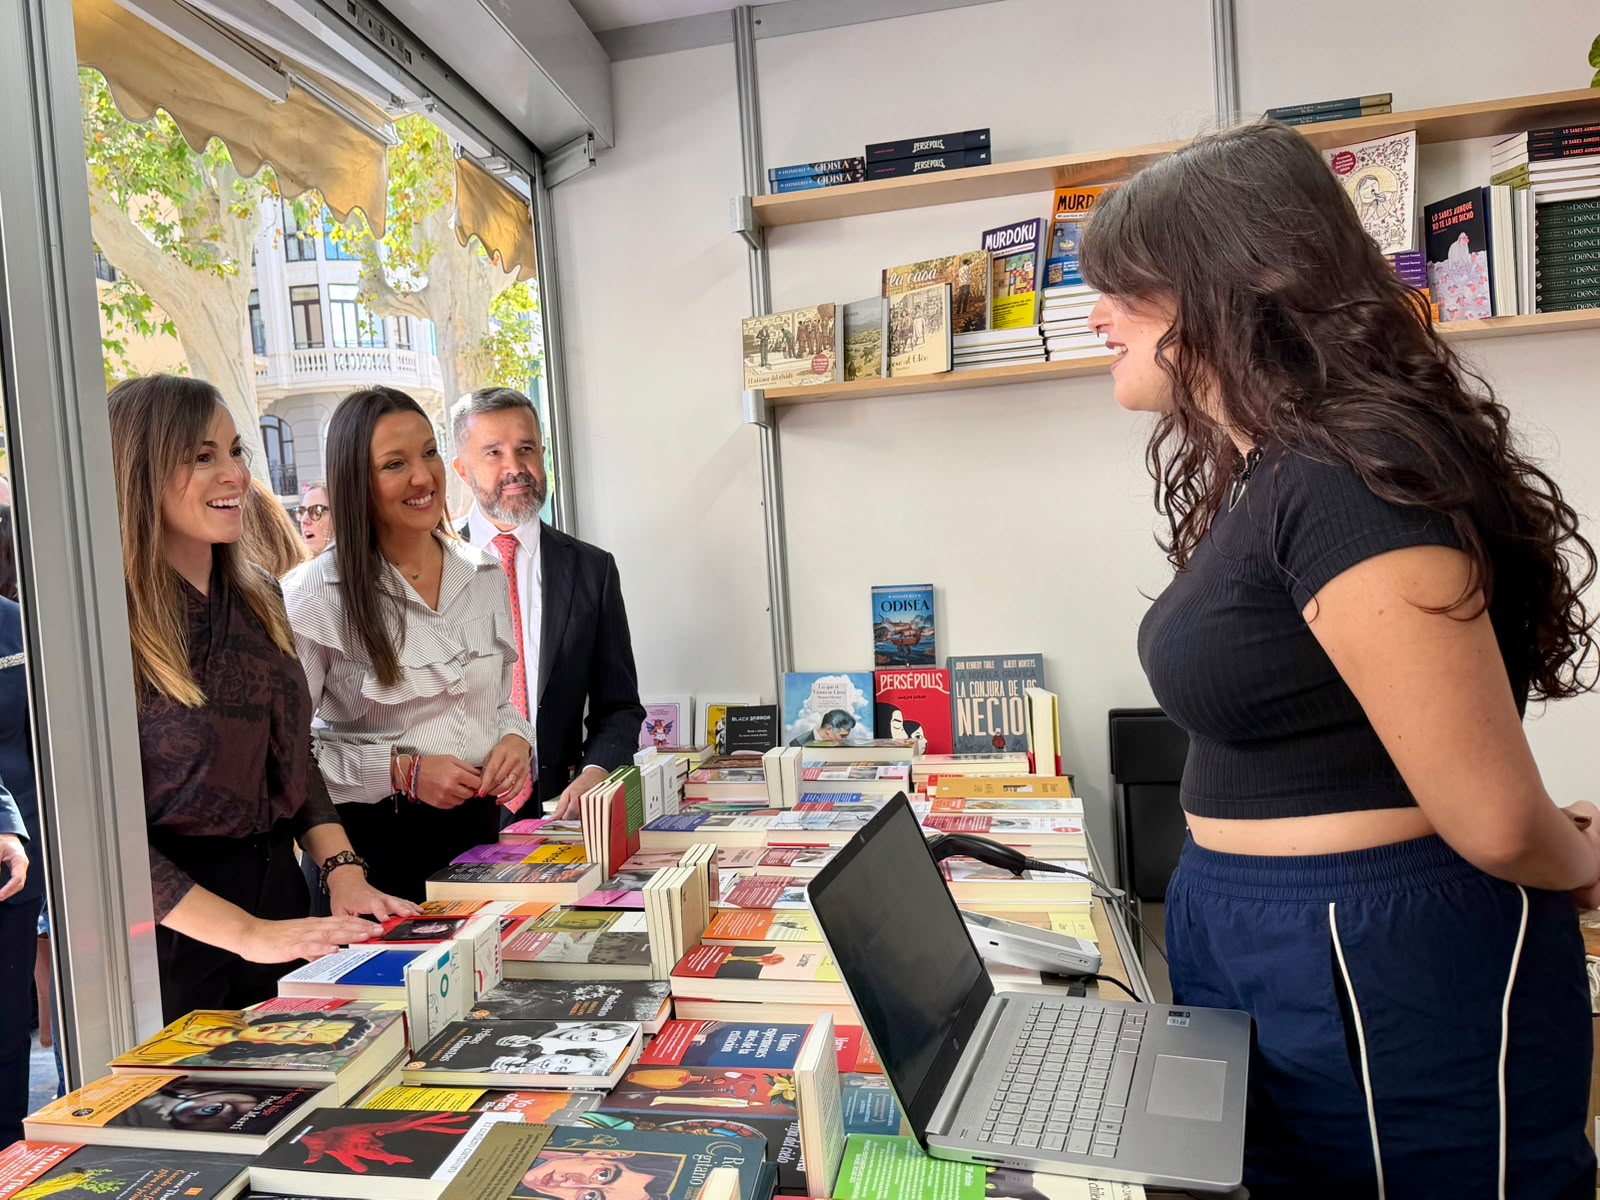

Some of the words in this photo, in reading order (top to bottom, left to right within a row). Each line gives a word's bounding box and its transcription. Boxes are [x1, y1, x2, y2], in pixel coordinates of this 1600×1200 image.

[913, 139, 945, 153] PERSÉPOLIS
[782, 167, 806, 175] HOMERO
[815, 160, 849, 172] ODISEA
[913, 158, 946, 172] PERSÉPOLIS
[817, 173, 852, 185] ODISEA
[1057, 193, 1096, 211] MURD
[1432, 213, 1438, 222] LO
[1439, 208, 1453, 219] SABES
[1432, 222, 1439, 230] NO
[1439, 219, 1446, 228] TE
[1446, 217, 1452, 227] LO
[1459, 210, 1474, 223] DICHO
[985, 222, 1037, 250] MURDOKU
[889, 273, 904, 287] la
[907, 268, 938, 284] casa
[880, 600, 930, 612] ODISEA
[955, 661, 965, 670] JOHN
[965, 660, 982, 670] KENNEDY
[983, 660, 995, 669] TOOLE
[955, 672, 966, 681] LA
[968, 670, 999, 680] NOVELA
[1002, 667, 1036, 679] GRÁFICA
[877, 671, 950, 696] PERSÉPOLIS
[955, 681, 966, 698] LA
[969, 680, 1005, 698] CONJURA
[1008, 680, 1019, 697] DE
[957, 697, 1024, 737] NECIO
[720, 1030, 743, 1052] extinción
[775, 1033, 801, 1052] Últimos
[777, 1147, 796, 1165] cielo
[690, 1154, 717, 1186] gitano
